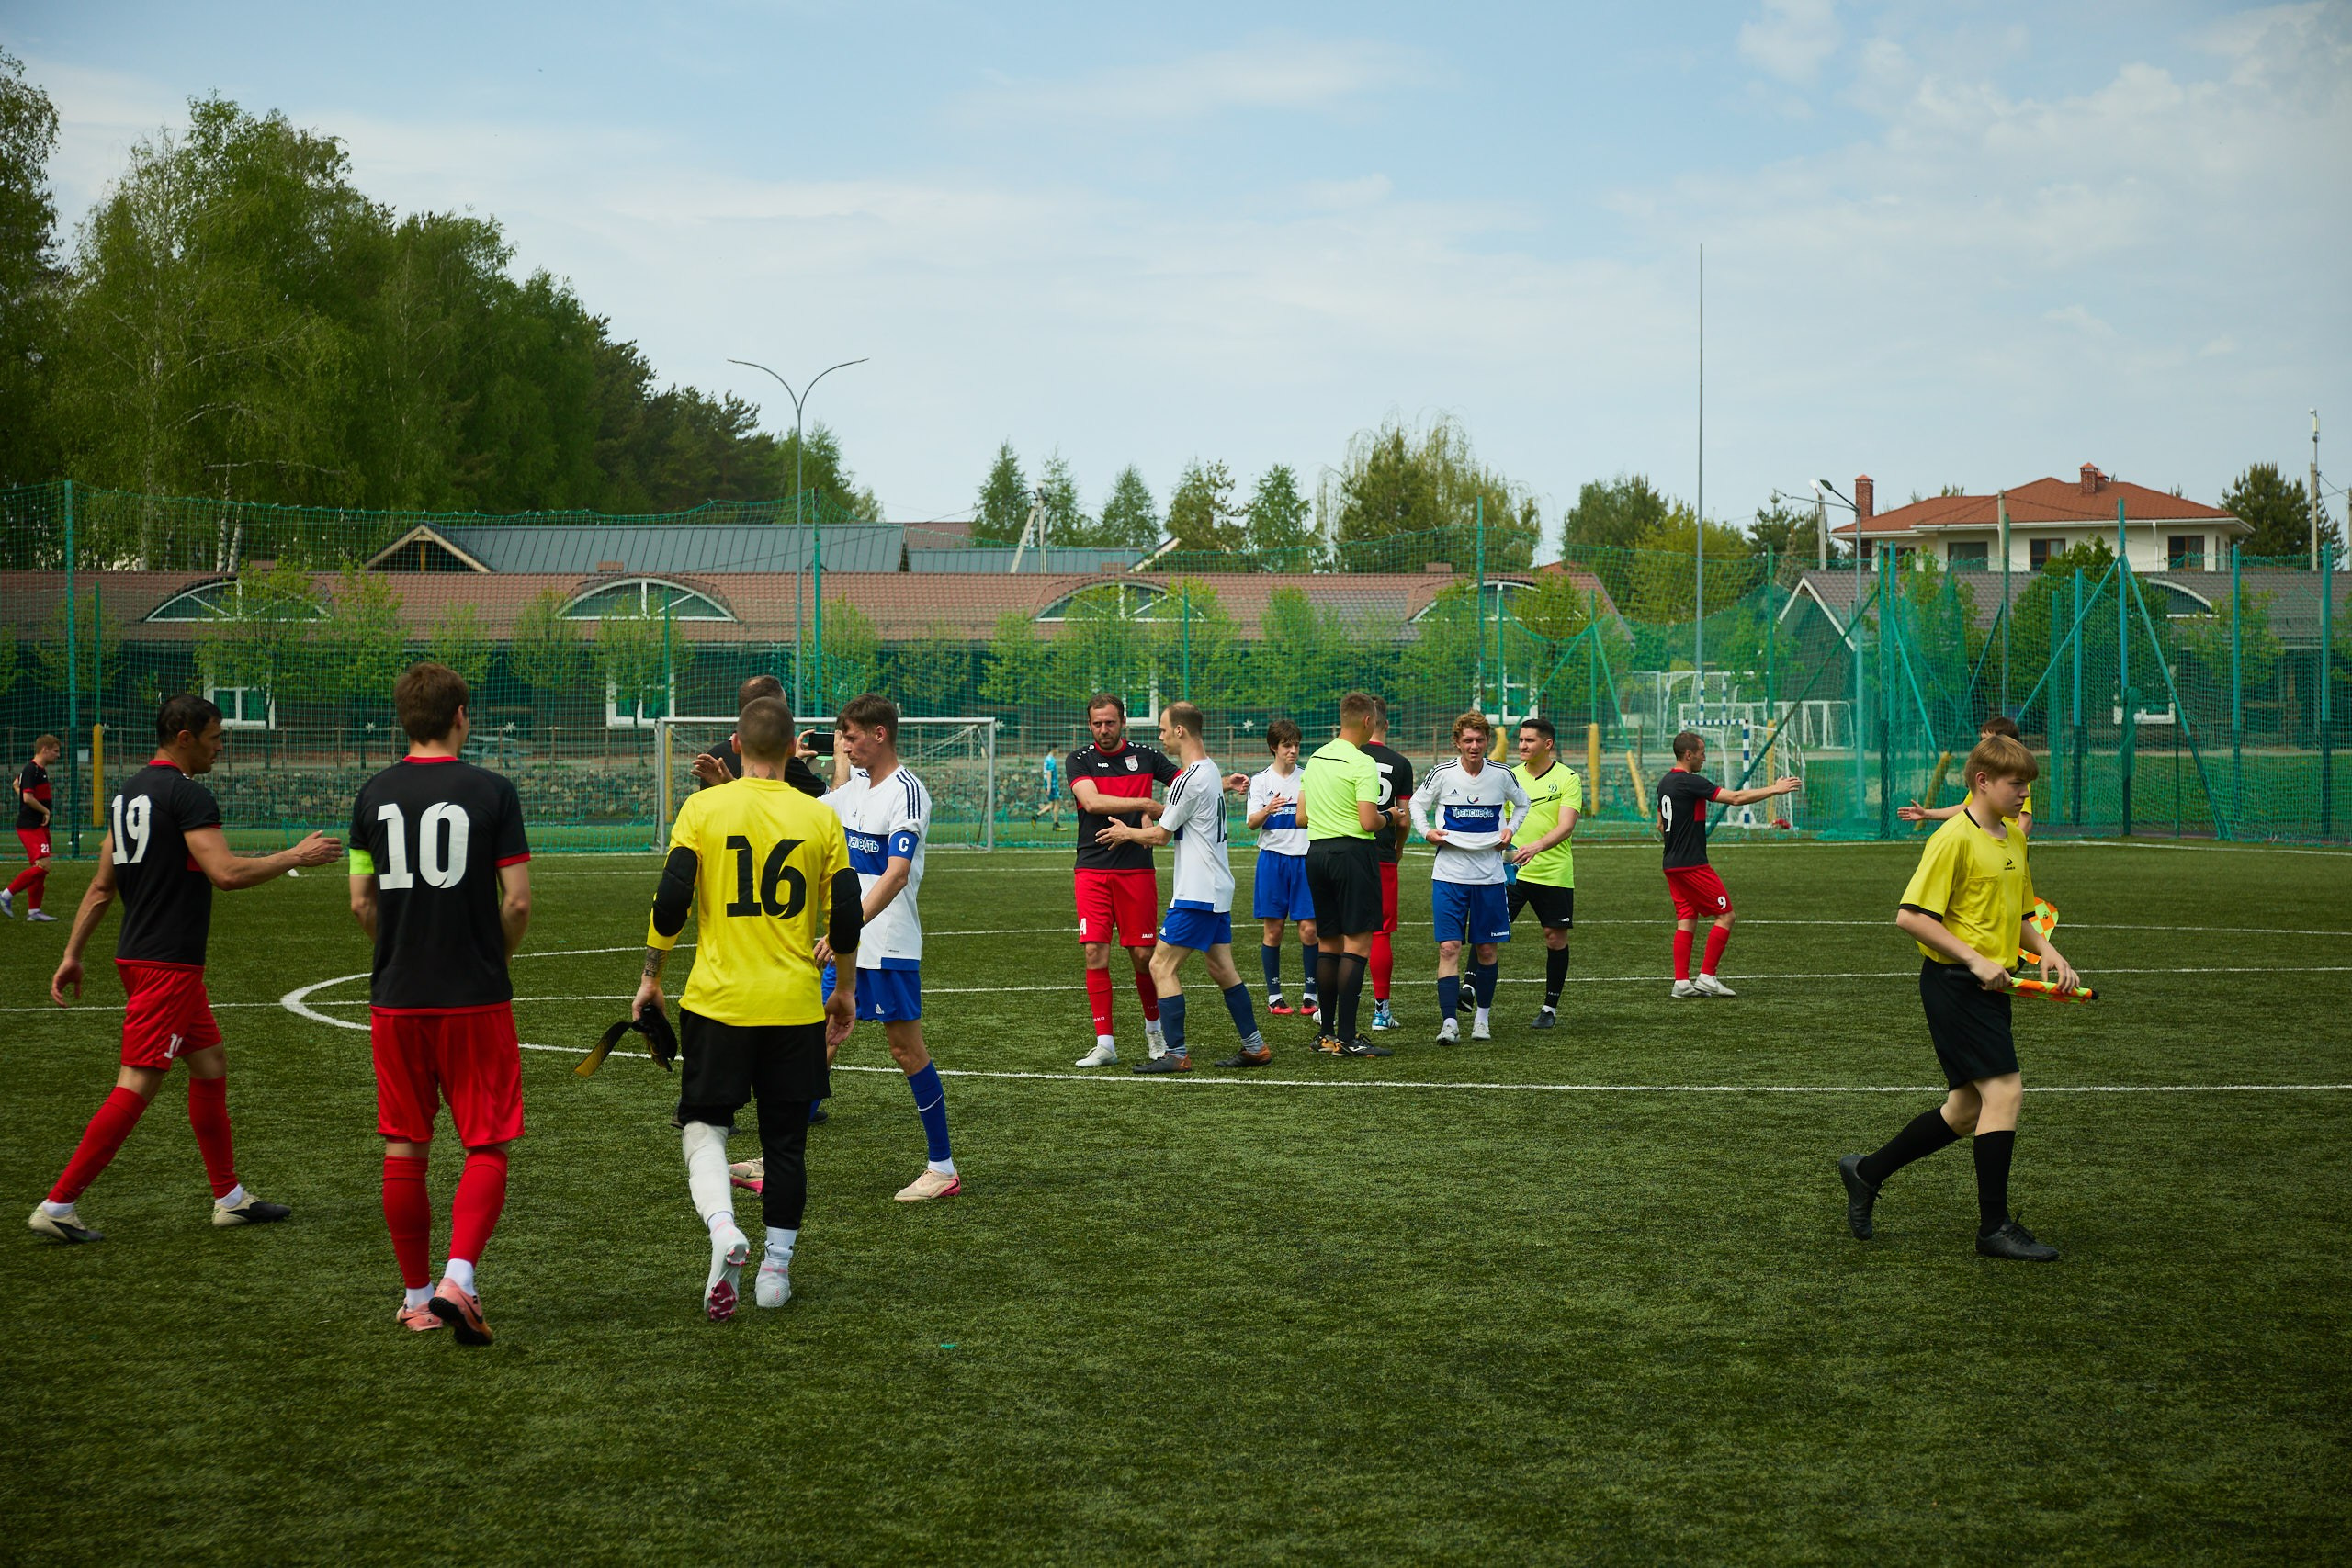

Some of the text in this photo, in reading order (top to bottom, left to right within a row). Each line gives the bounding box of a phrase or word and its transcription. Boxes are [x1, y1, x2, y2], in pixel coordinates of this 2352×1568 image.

[1375, 762, 1393, 805] 5
[111, 794, 152, 865] 19
[1661, 795, 1672, 832] 9
[377, 801, 469, 890] 10
[899, 837, 910, 852] C
[726, 835, 807, 919] 16
[1717, 896, 1726, 909] 9
[1080, 918, 1087, 935] 4
